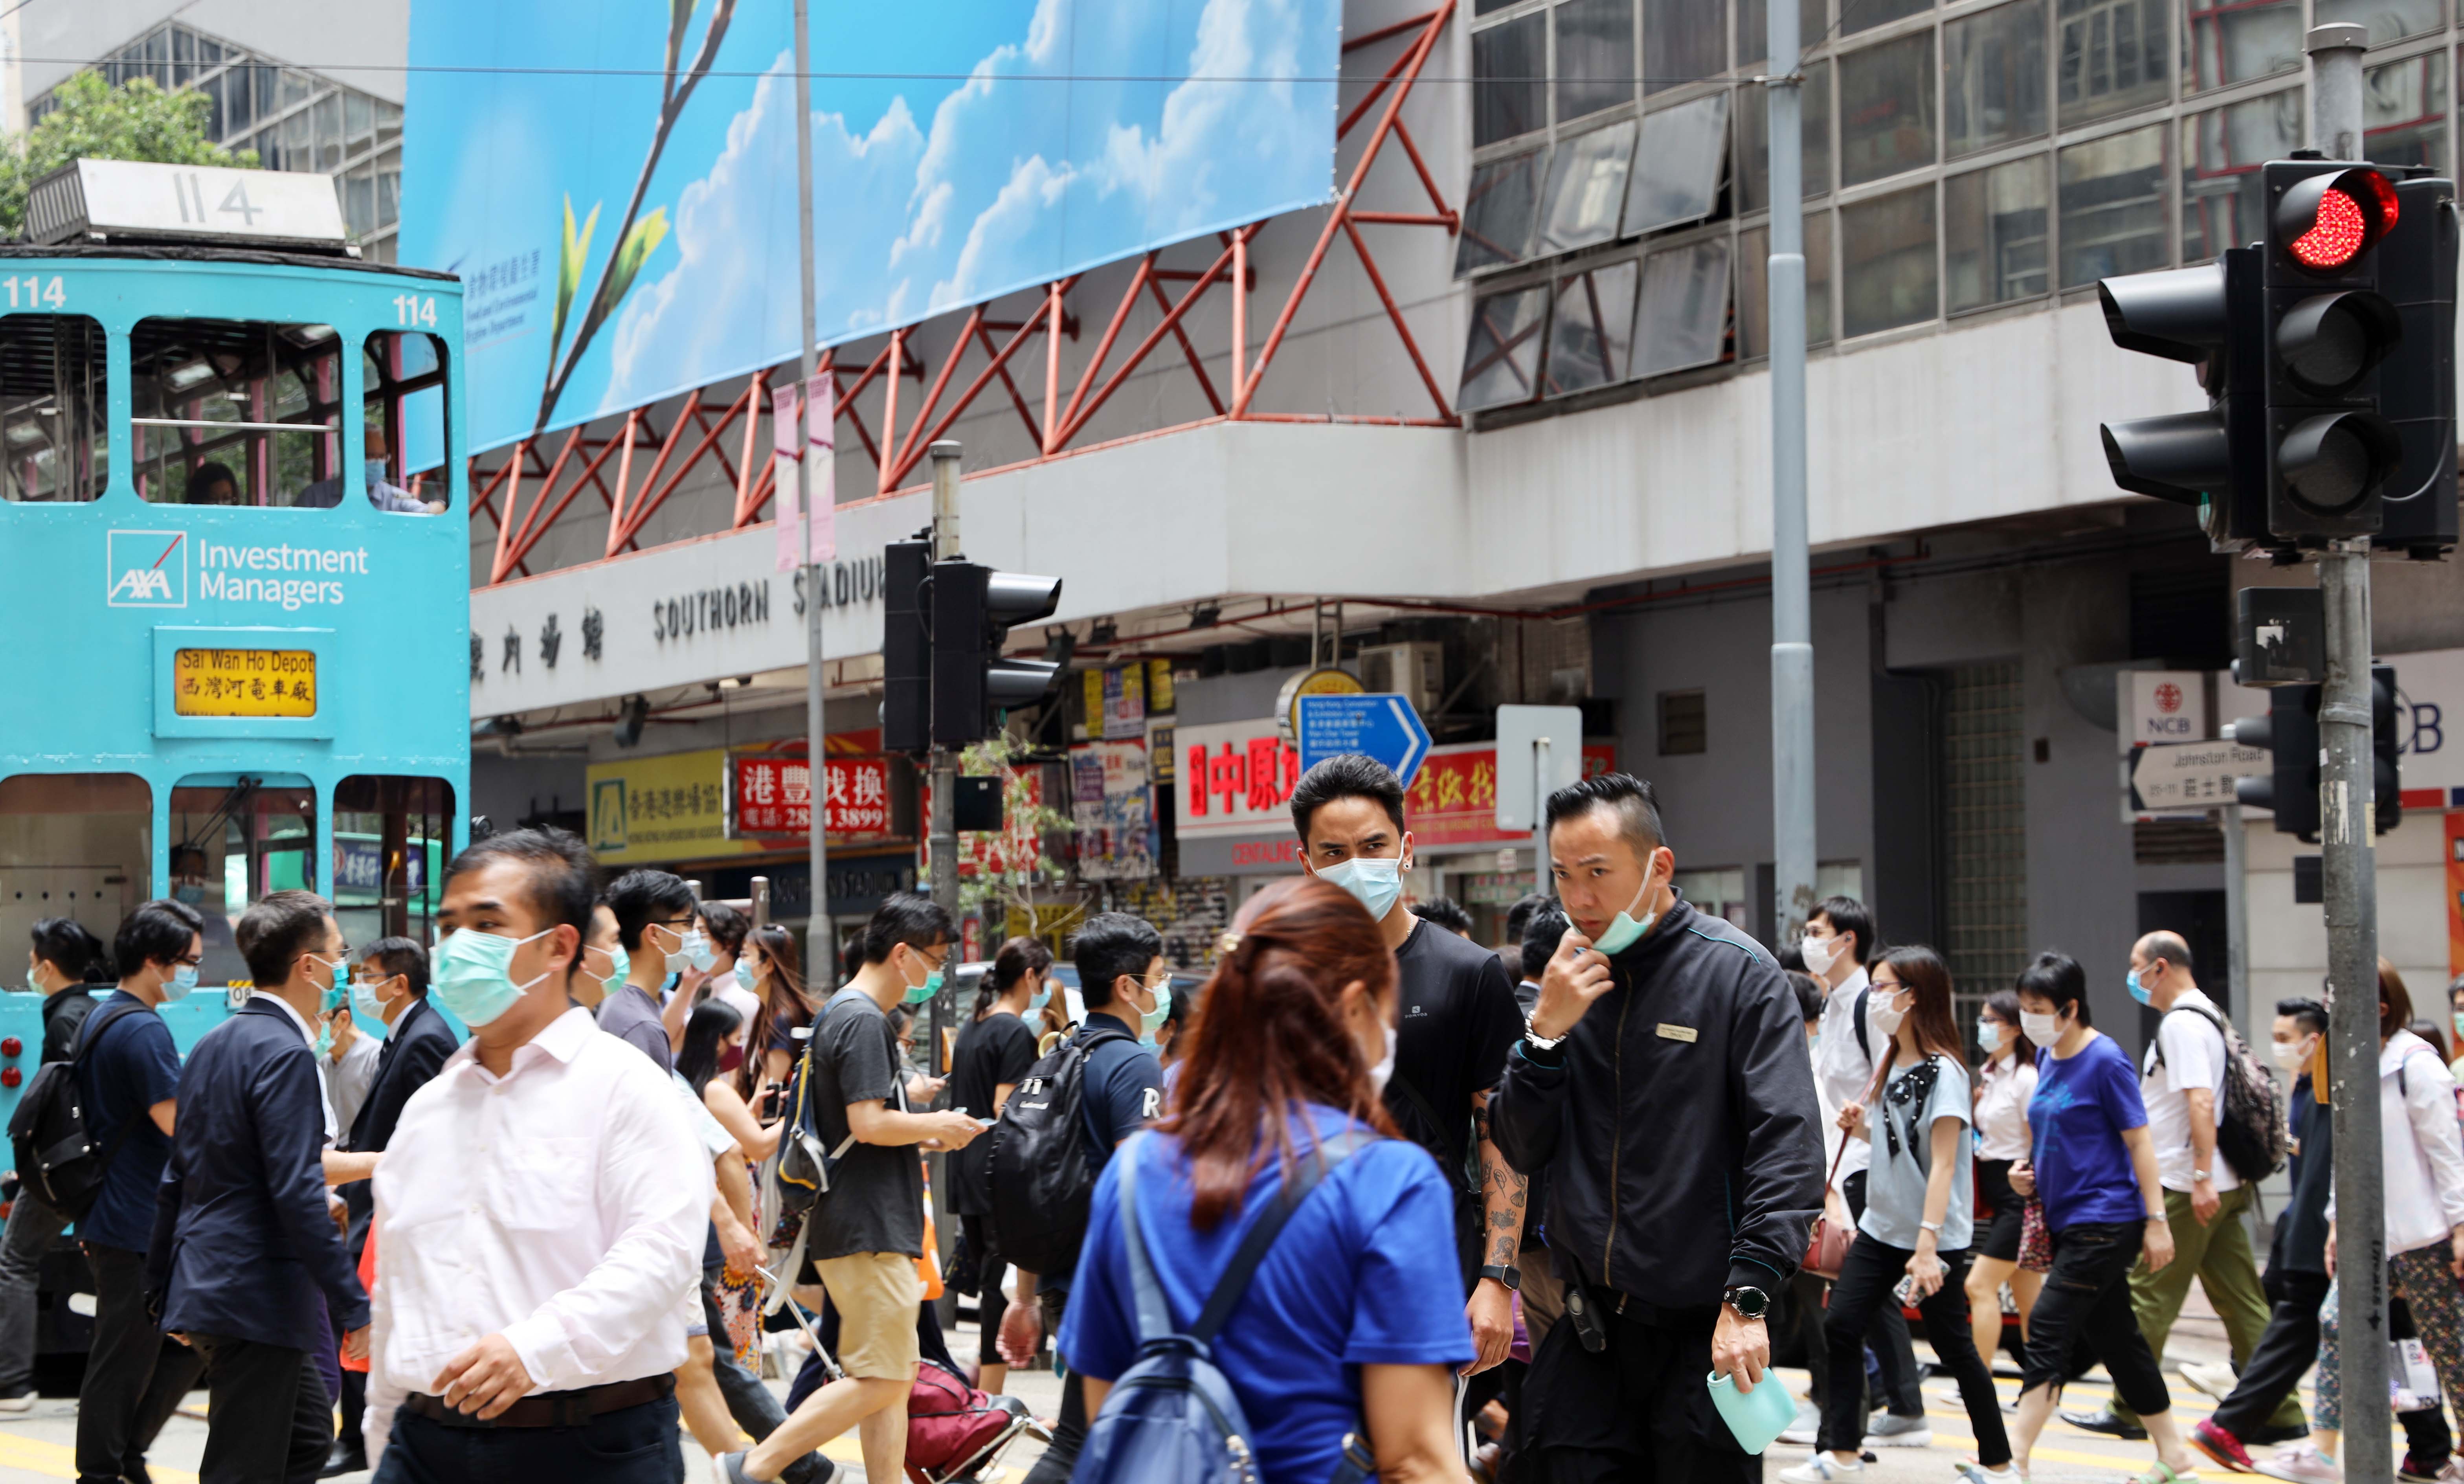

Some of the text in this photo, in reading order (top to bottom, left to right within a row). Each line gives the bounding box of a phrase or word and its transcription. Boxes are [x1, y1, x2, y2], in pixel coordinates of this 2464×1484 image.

[174, 174, 263, 225] 114
[3, 276, 66, 308] 114
[393, 295, 437, 327] 114
[200, 538, 369, 575] Investment
[110, 569, 172, 599] AXA
[200, 571, 344, 611] Managers
[654, 556, 885, 642] SOUTHORN SADIU
[182, 650, 313, 676] Sai Wan Ho Depot
[183, 676, 312, 702] 西灣河電車廠
[2147, 717, 2190, 734] NCB
[2173, 747, 2264, 768] Johnston Road
[629, 781, 723, 821] 香港遊樂場協
[786, 807, 832, 828] 284
[835, 807, 884, 828] 3899
